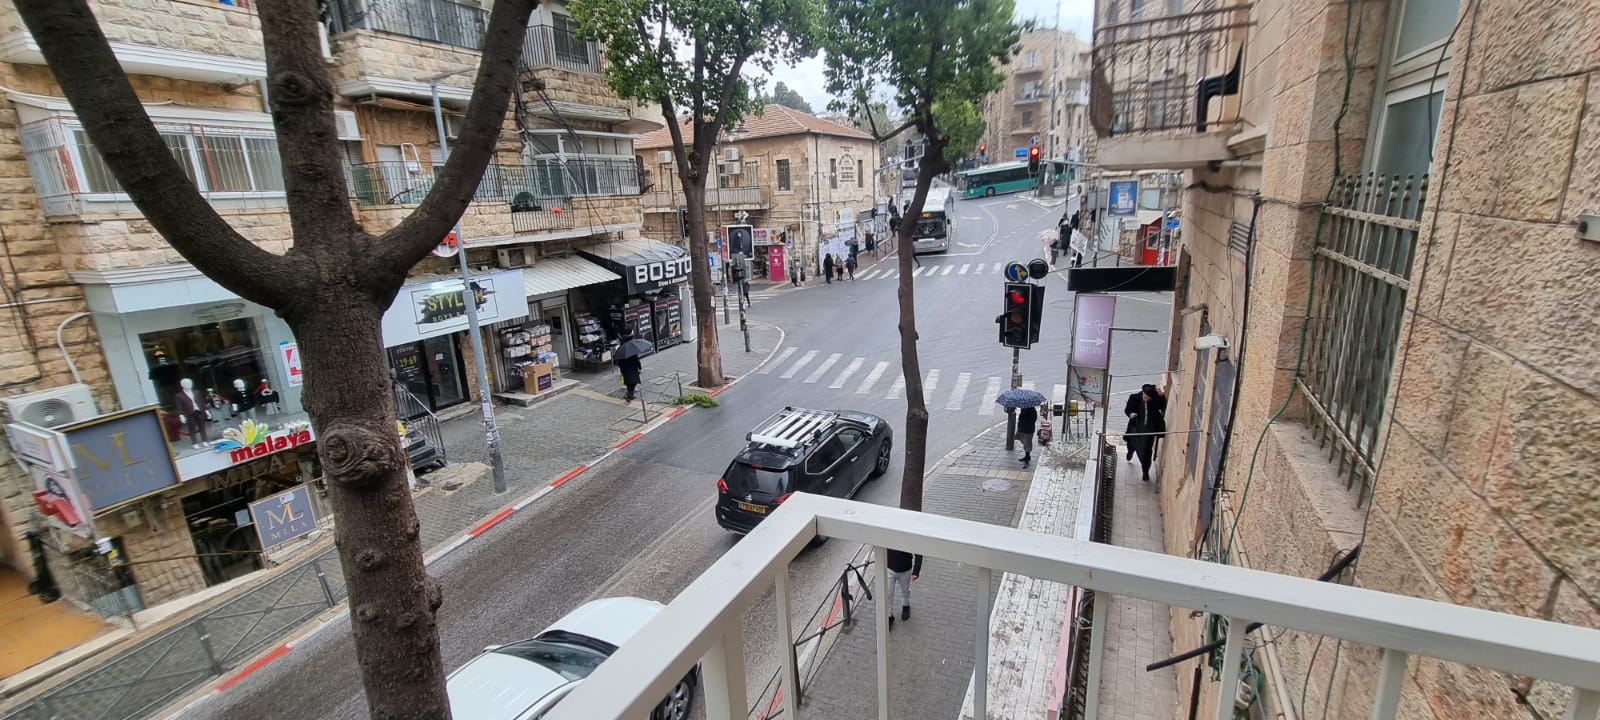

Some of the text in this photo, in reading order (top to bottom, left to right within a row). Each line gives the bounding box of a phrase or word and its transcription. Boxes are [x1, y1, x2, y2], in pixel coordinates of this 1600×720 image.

[635, 255, 692, 284] BOSTO
[427, 288, 484, 312] STYLH
[230, 430, 312, 463] malaya
[271, 521, 307, 540] MILA
